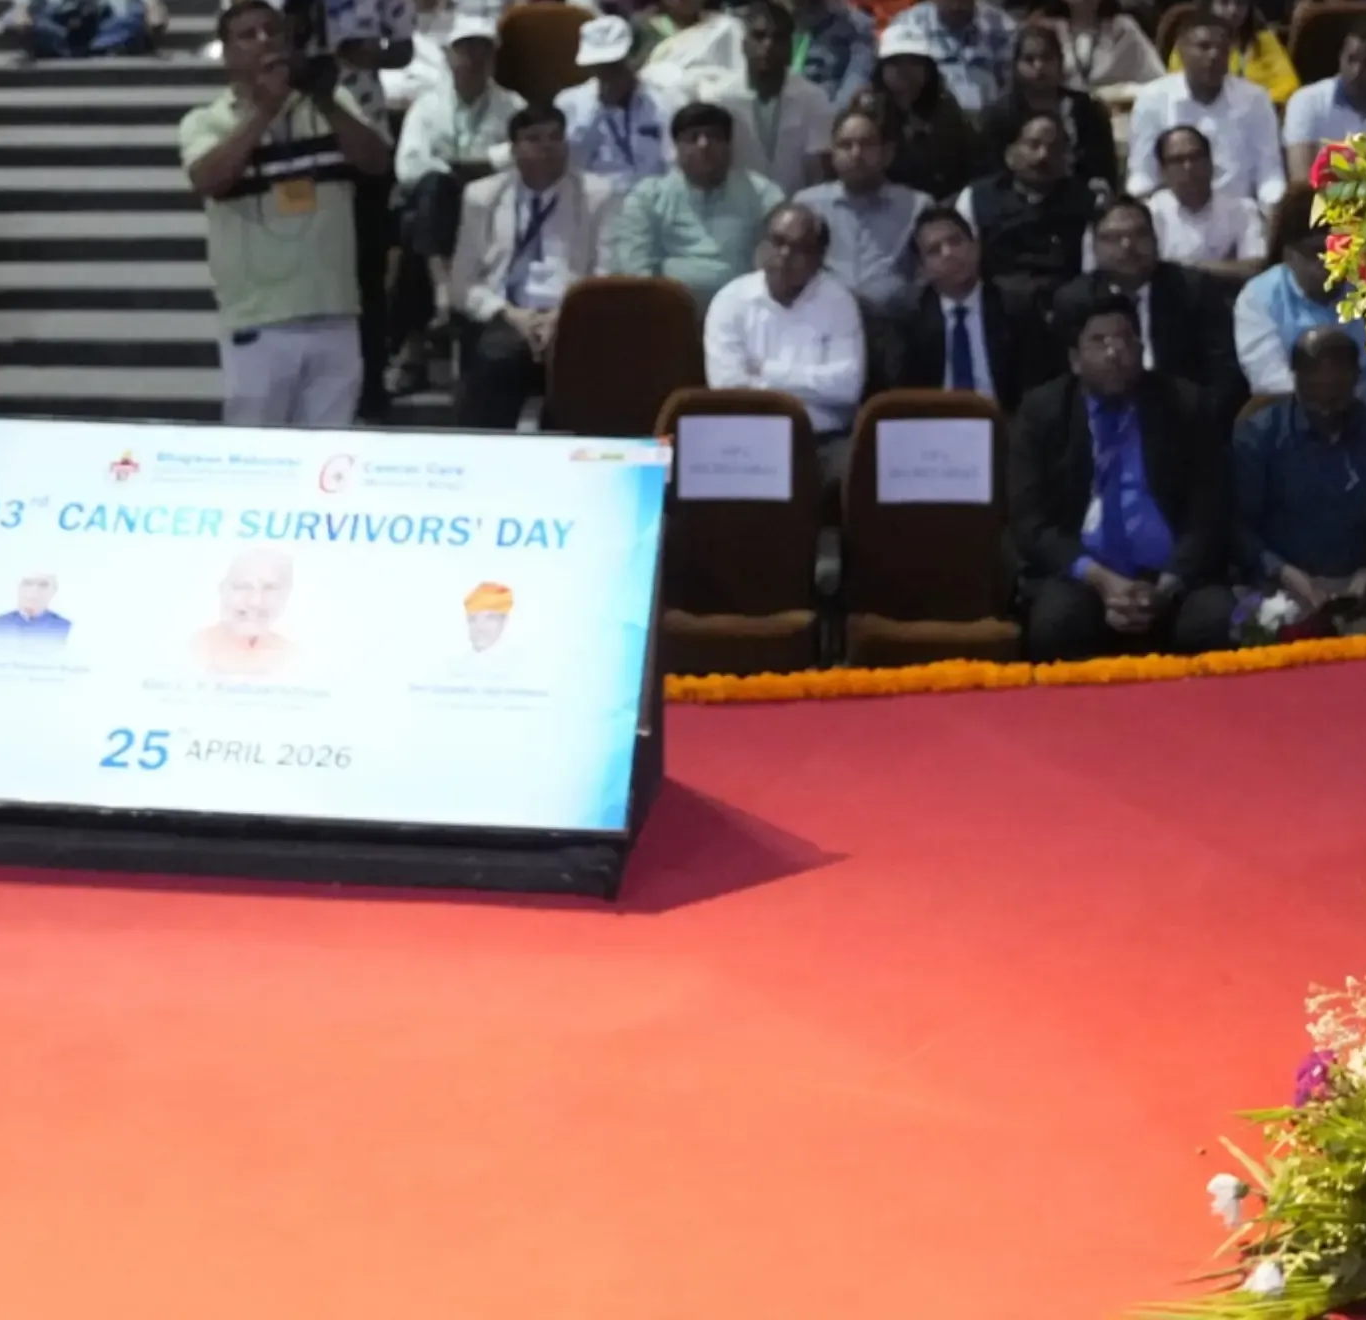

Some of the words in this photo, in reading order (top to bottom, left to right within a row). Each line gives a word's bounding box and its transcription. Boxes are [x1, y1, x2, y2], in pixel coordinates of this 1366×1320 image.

[57, 501, 224, 538] CANCER
[236, 508, 483, 547] SURVIVORS'
[495, 516, 576, 549] DAY
[185, 739, 267, 764] APRIL
[276, 743, 353, 770] 2026
